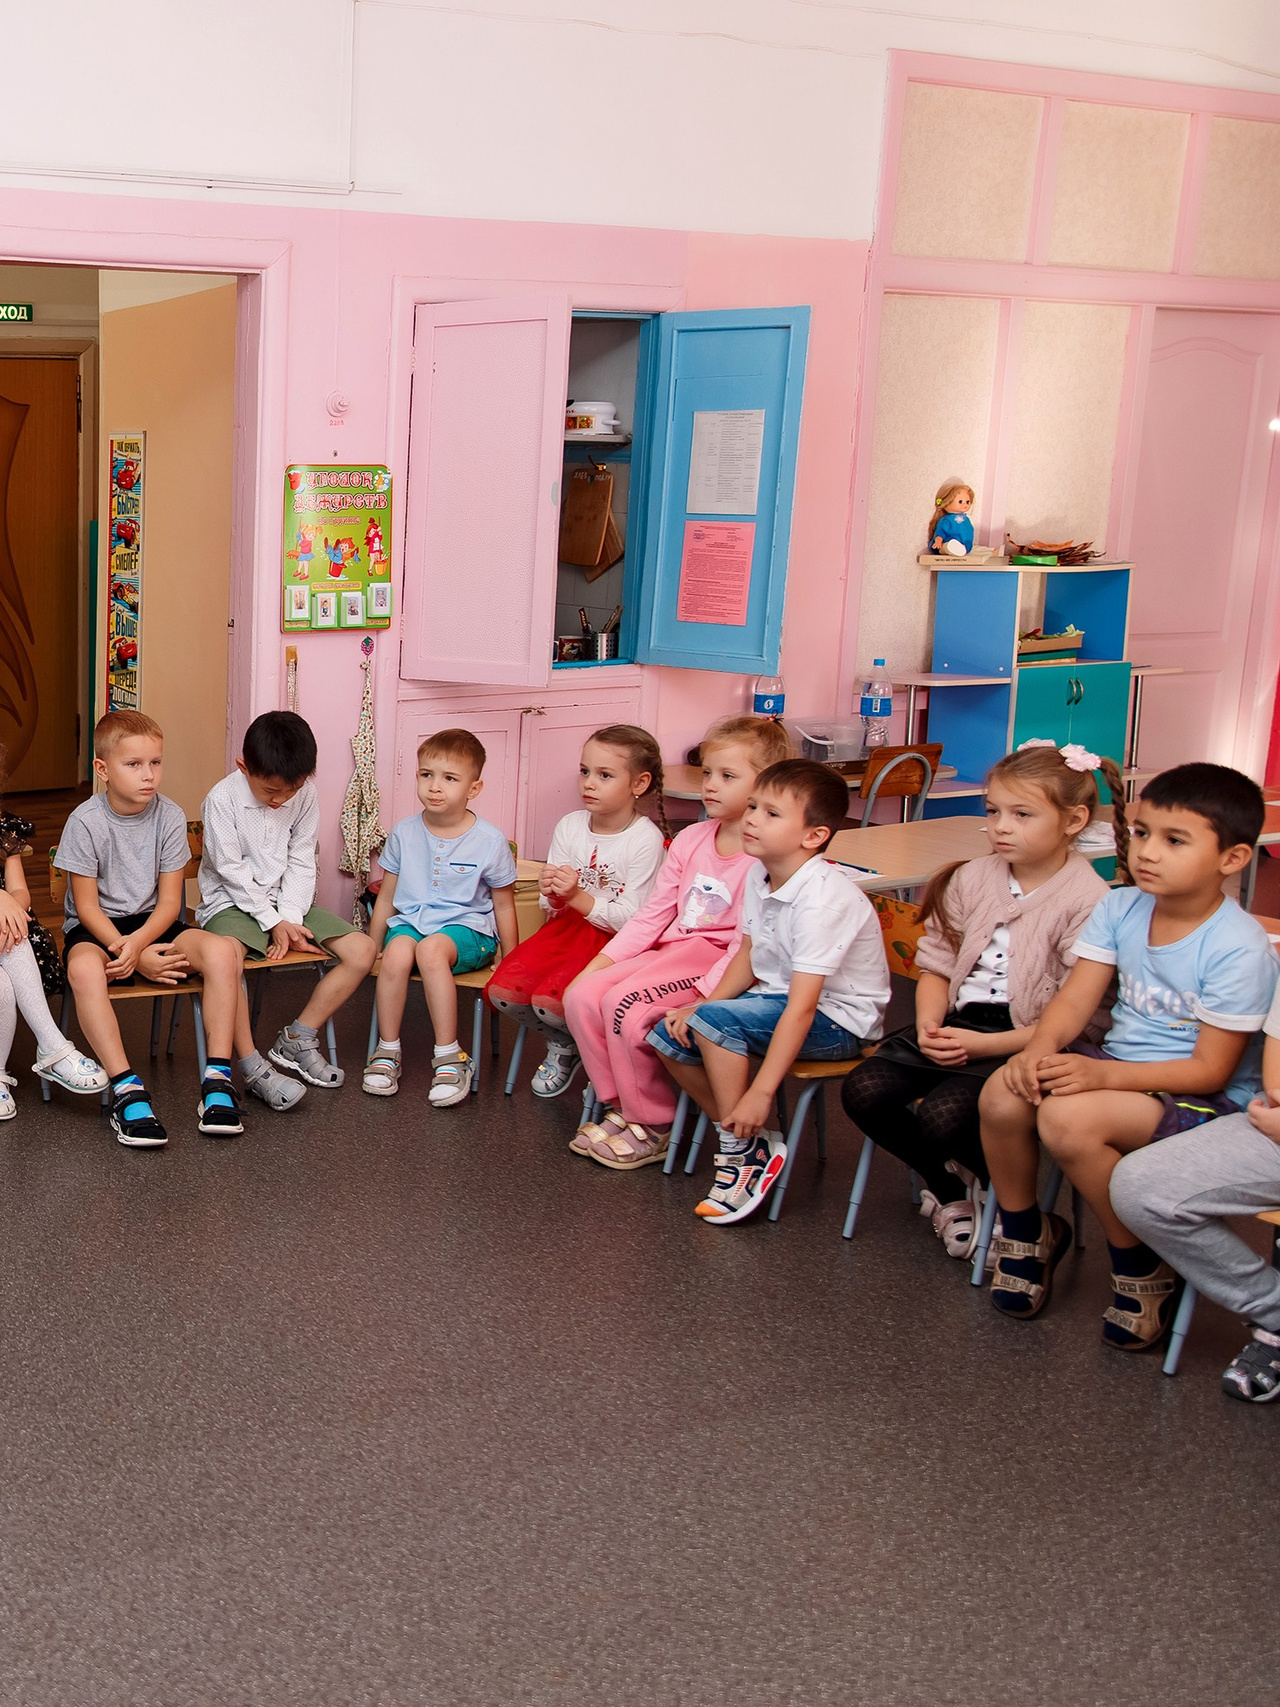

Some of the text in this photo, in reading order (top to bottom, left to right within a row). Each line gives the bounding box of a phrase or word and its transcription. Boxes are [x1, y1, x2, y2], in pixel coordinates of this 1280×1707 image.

[305, 470, 375, 491] УГОЛОК
[293, 493, 388, 514] ДЕЖУРСТВ
[613, 975, 705, 1036] most Famous
